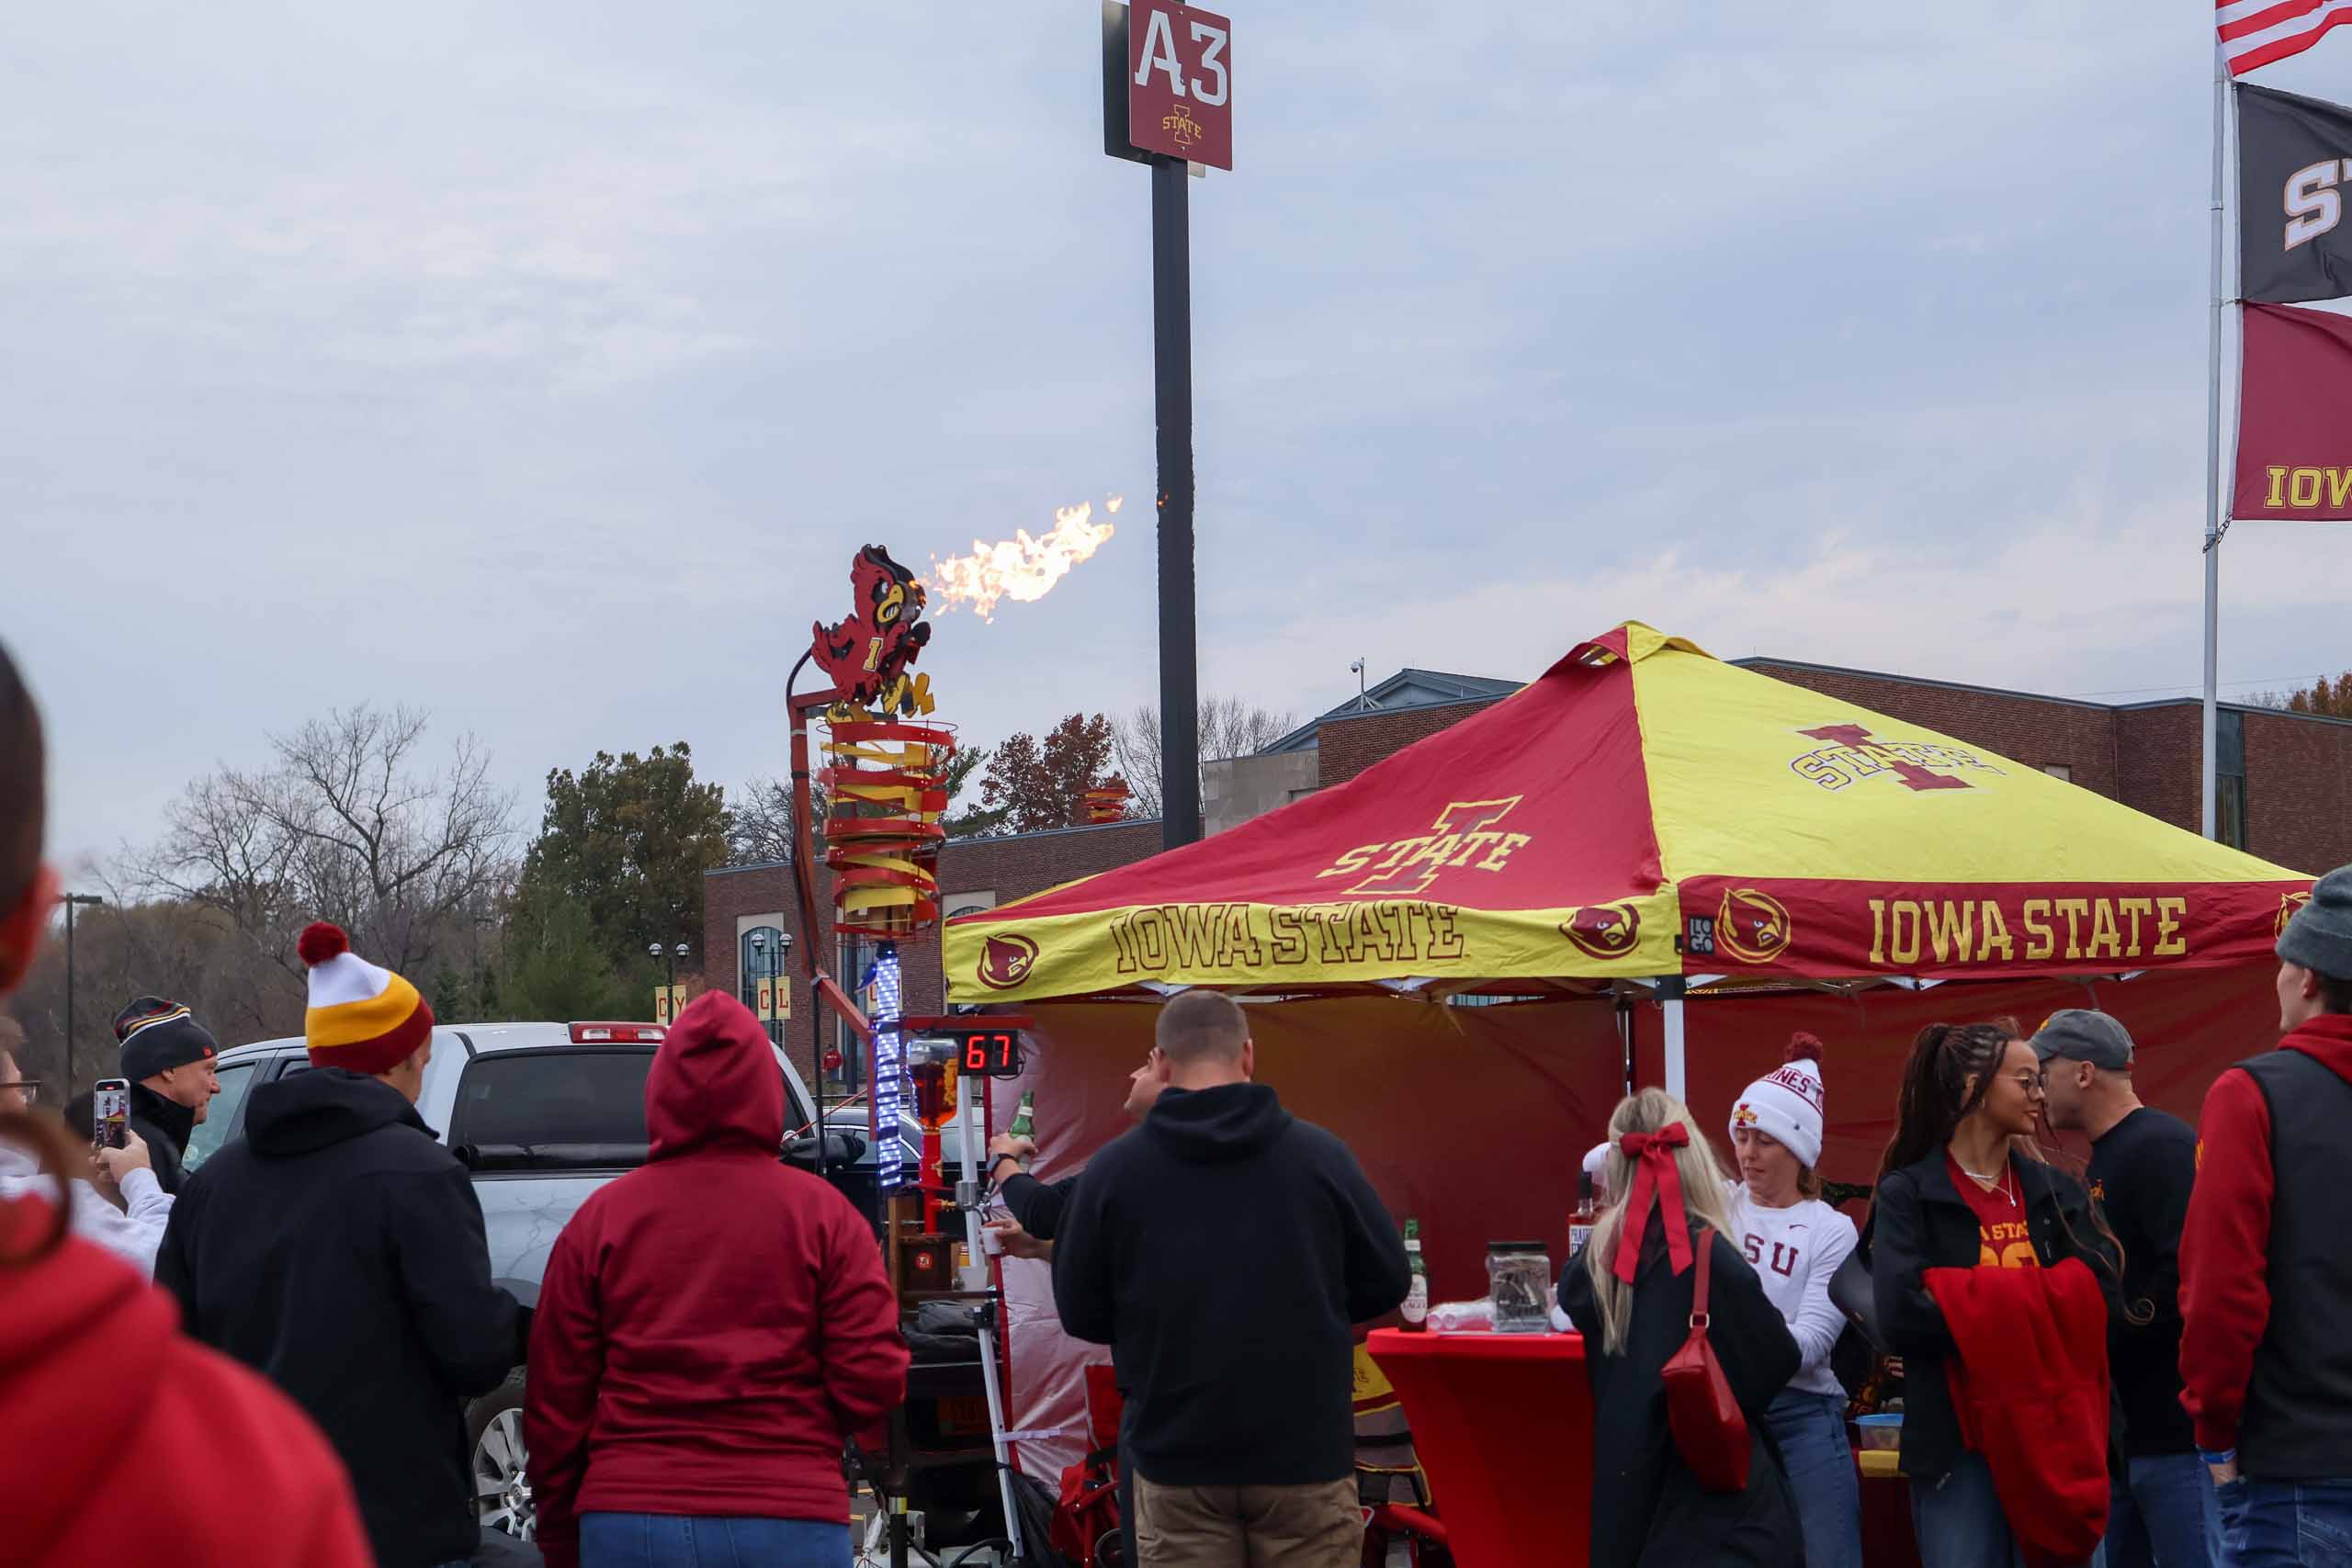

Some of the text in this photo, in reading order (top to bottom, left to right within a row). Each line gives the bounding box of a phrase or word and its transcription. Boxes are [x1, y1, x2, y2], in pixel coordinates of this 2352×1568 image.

[1135, 9, 1227, 107] A3
[1162, 116, 1202, 140] STATE
[2284, 158, 2352, 250] S
[1316, 831, 1532, 878] STATE
[1110, 902, 1465, 974] IOWA STATE
[1869, 897, 2187, 963] IOWA STATE
[967, 1035, 1010, 1069] 67
[1992, 1222, 2029, 1240] STA
